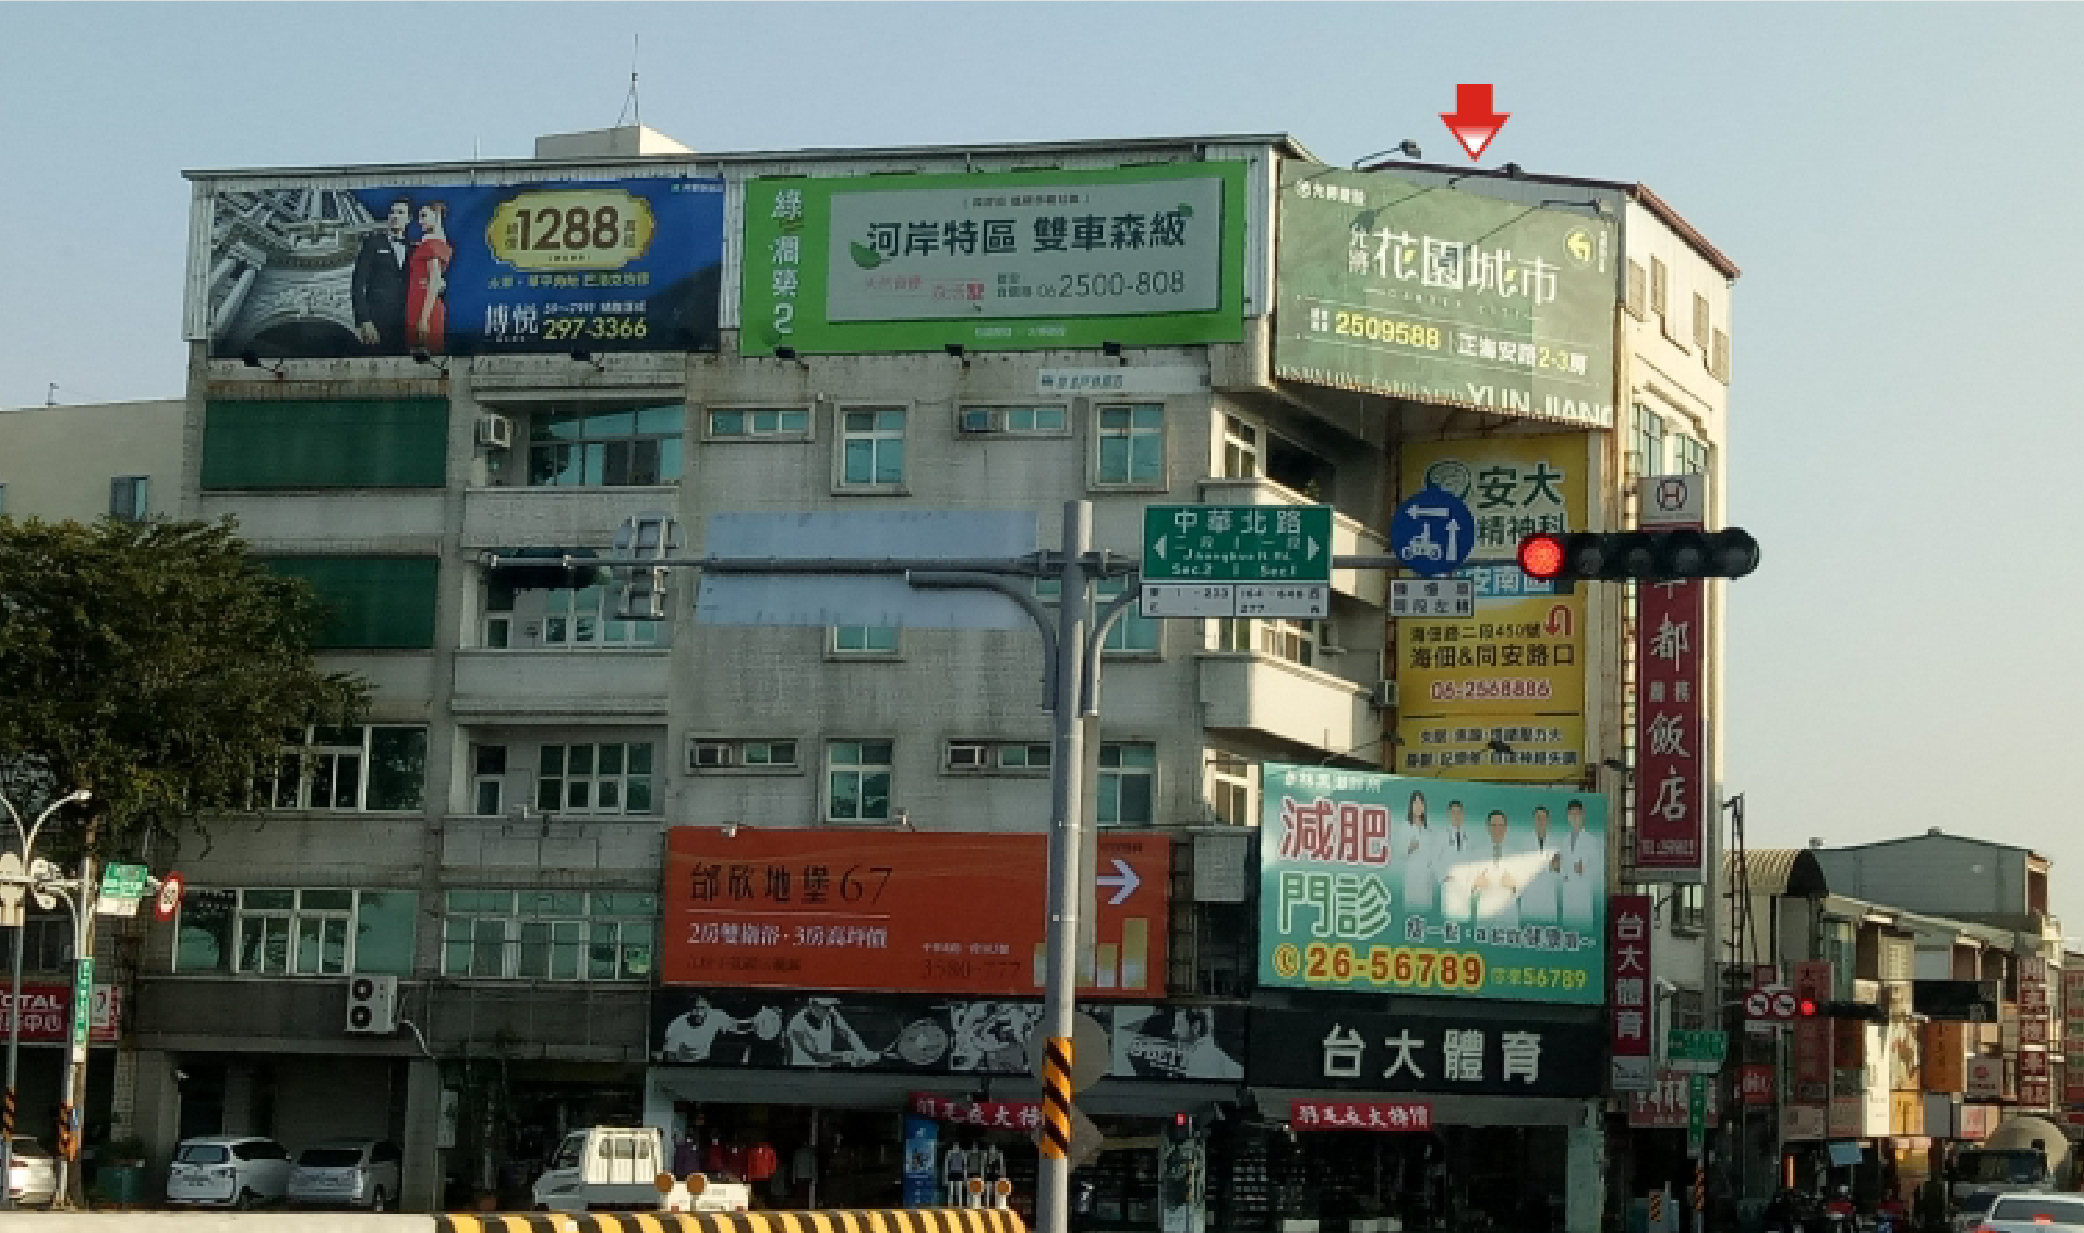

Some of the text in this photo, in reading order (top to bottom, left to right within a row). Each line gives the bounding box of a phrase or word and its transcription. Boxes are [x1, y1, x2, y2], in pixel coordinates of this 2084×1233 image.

[515, 206, 619, 251] 1288
[867, 211, 1187, 258] 河岸特區 雙車森級
[1059, 270, 1185, 298] 2500-808
[1373, 228, 1562, 305] 花園城市
[542, 317, 648, 340] 297-3366
[1477, 464, 1563, 508] 安大
[1174, 509, 1302, 534] 中華北路
[1410, 645, 1575, 668] 海佃&同安路口
[1647, 711, 1692, 822] 飯店
[1279, 797, 1392, 868] 減肥
[1279, 870, 1392, 939] 門診
[1306, 945, 1484, 989] 26-56789
[1616, 911, 1645, 1041] 台大體育
[0, 992, 64, 1010] OTAL
[1322, 1022, 1543, 1084] 台大體育
